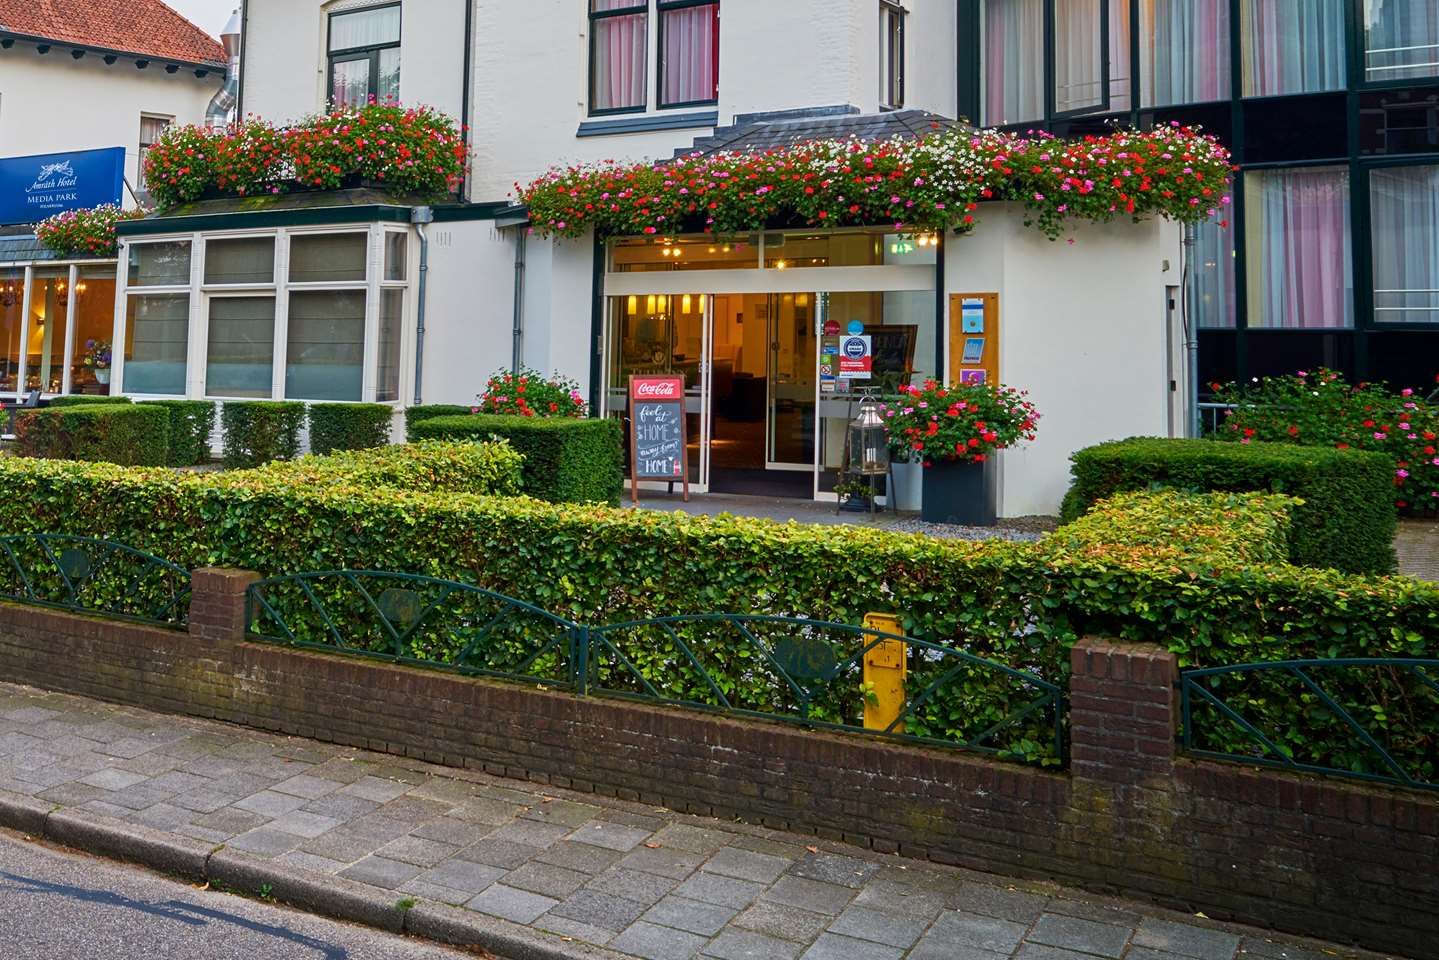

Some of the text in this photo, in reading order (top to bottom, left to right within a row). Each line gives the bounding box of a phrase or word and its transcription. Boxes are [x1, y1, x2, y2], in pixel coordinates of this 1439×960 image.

[57, 176, 77, 187] Hotel
[27, 193, 77, 203] MEDIA PARK
[640, 405, 663, 422] feel
[655, 411, 666, 422] at
[644, 424, 669, 440] HOME
[640, 446, 659, 457] away
[645, 460, 668, 473] HOME
